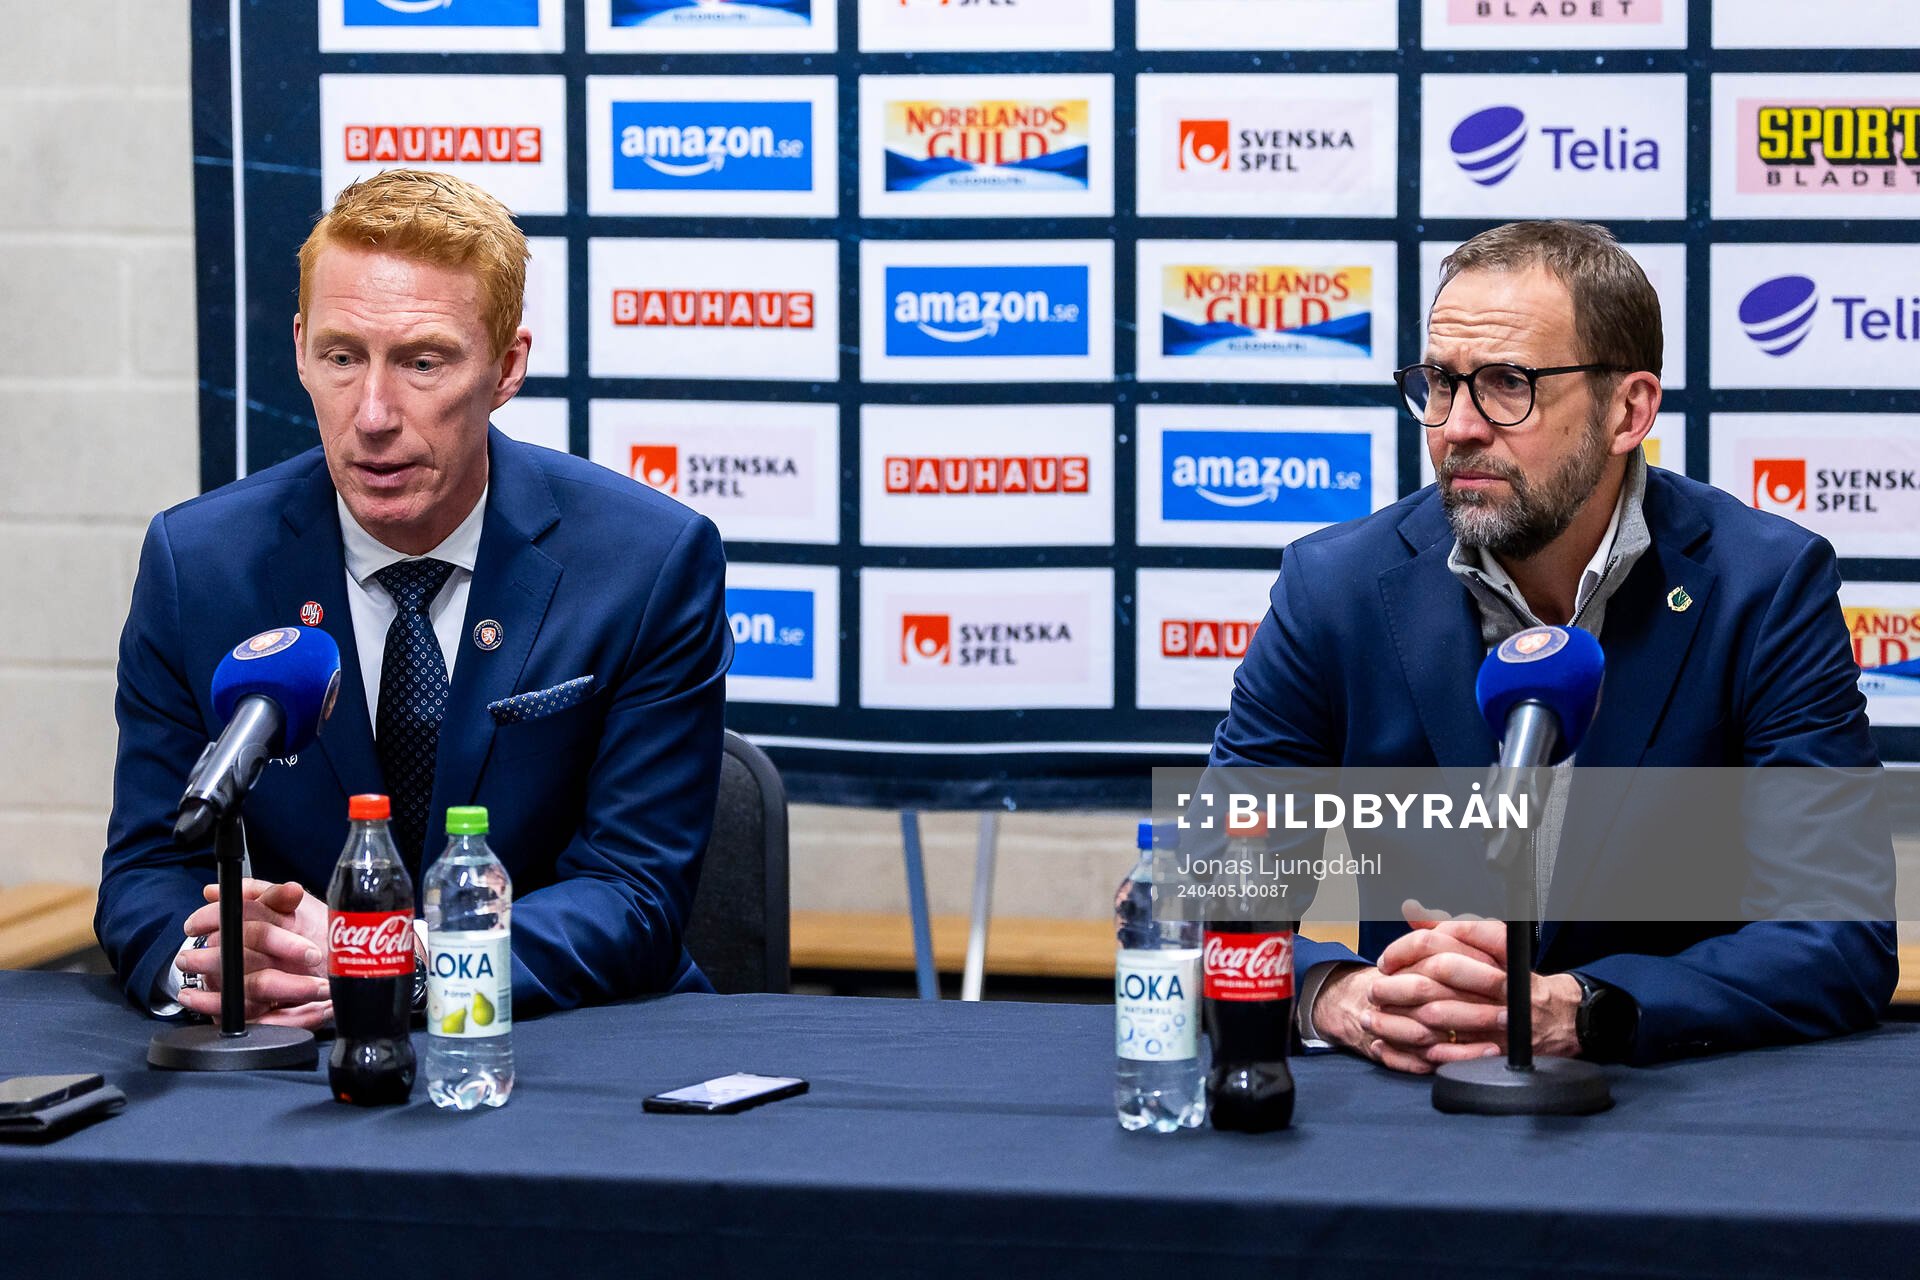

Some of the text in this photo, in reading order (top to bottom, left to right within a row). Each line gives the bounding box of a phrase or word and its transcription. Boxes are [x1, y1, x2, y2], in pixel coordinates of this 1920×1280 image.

[1477, 0, 1632, 17] BLADET
[905, 106, 1068, 135] NORRLANDS
[1758, 106, 1920, 165] SPORT
[347, 127, 541, 161] BAUHAUS
[621, 125, 804, 159] amazon.se
[927, 131, 1049, 166] GULD
[1240, 130, 1354, 149] SVENSKA
[1541, 126, 1660, 171] Telia
[1240, 152, 1298, 171] SPEL
[1184, 271, 1350, 301] NORRLANDS
[613, 290, 814, 328] BAUHAUS
[895, 289, 1079, 323] amazon.se
[1205, 297, 1331, 332] GULD
[1832, 296, 1920, 341] Teli
[687, 454, 798, 476] SVENSKA
[885, 456, 1089, 493] BAUHAUS
[1172, 455, 1361, 490] amazon.se
[1817, 469, 1920, 489] SVENSK
[687, 478, 745, 498] SPEL
[1817, 493, 1877, 512] SPEL
[729, 612, 805, 646] on.se
[958, 623, 1072, 644] SVENSKA
[958, 645, 1018, 666] SPEL
[428, 951, 494, 979] LOKA
